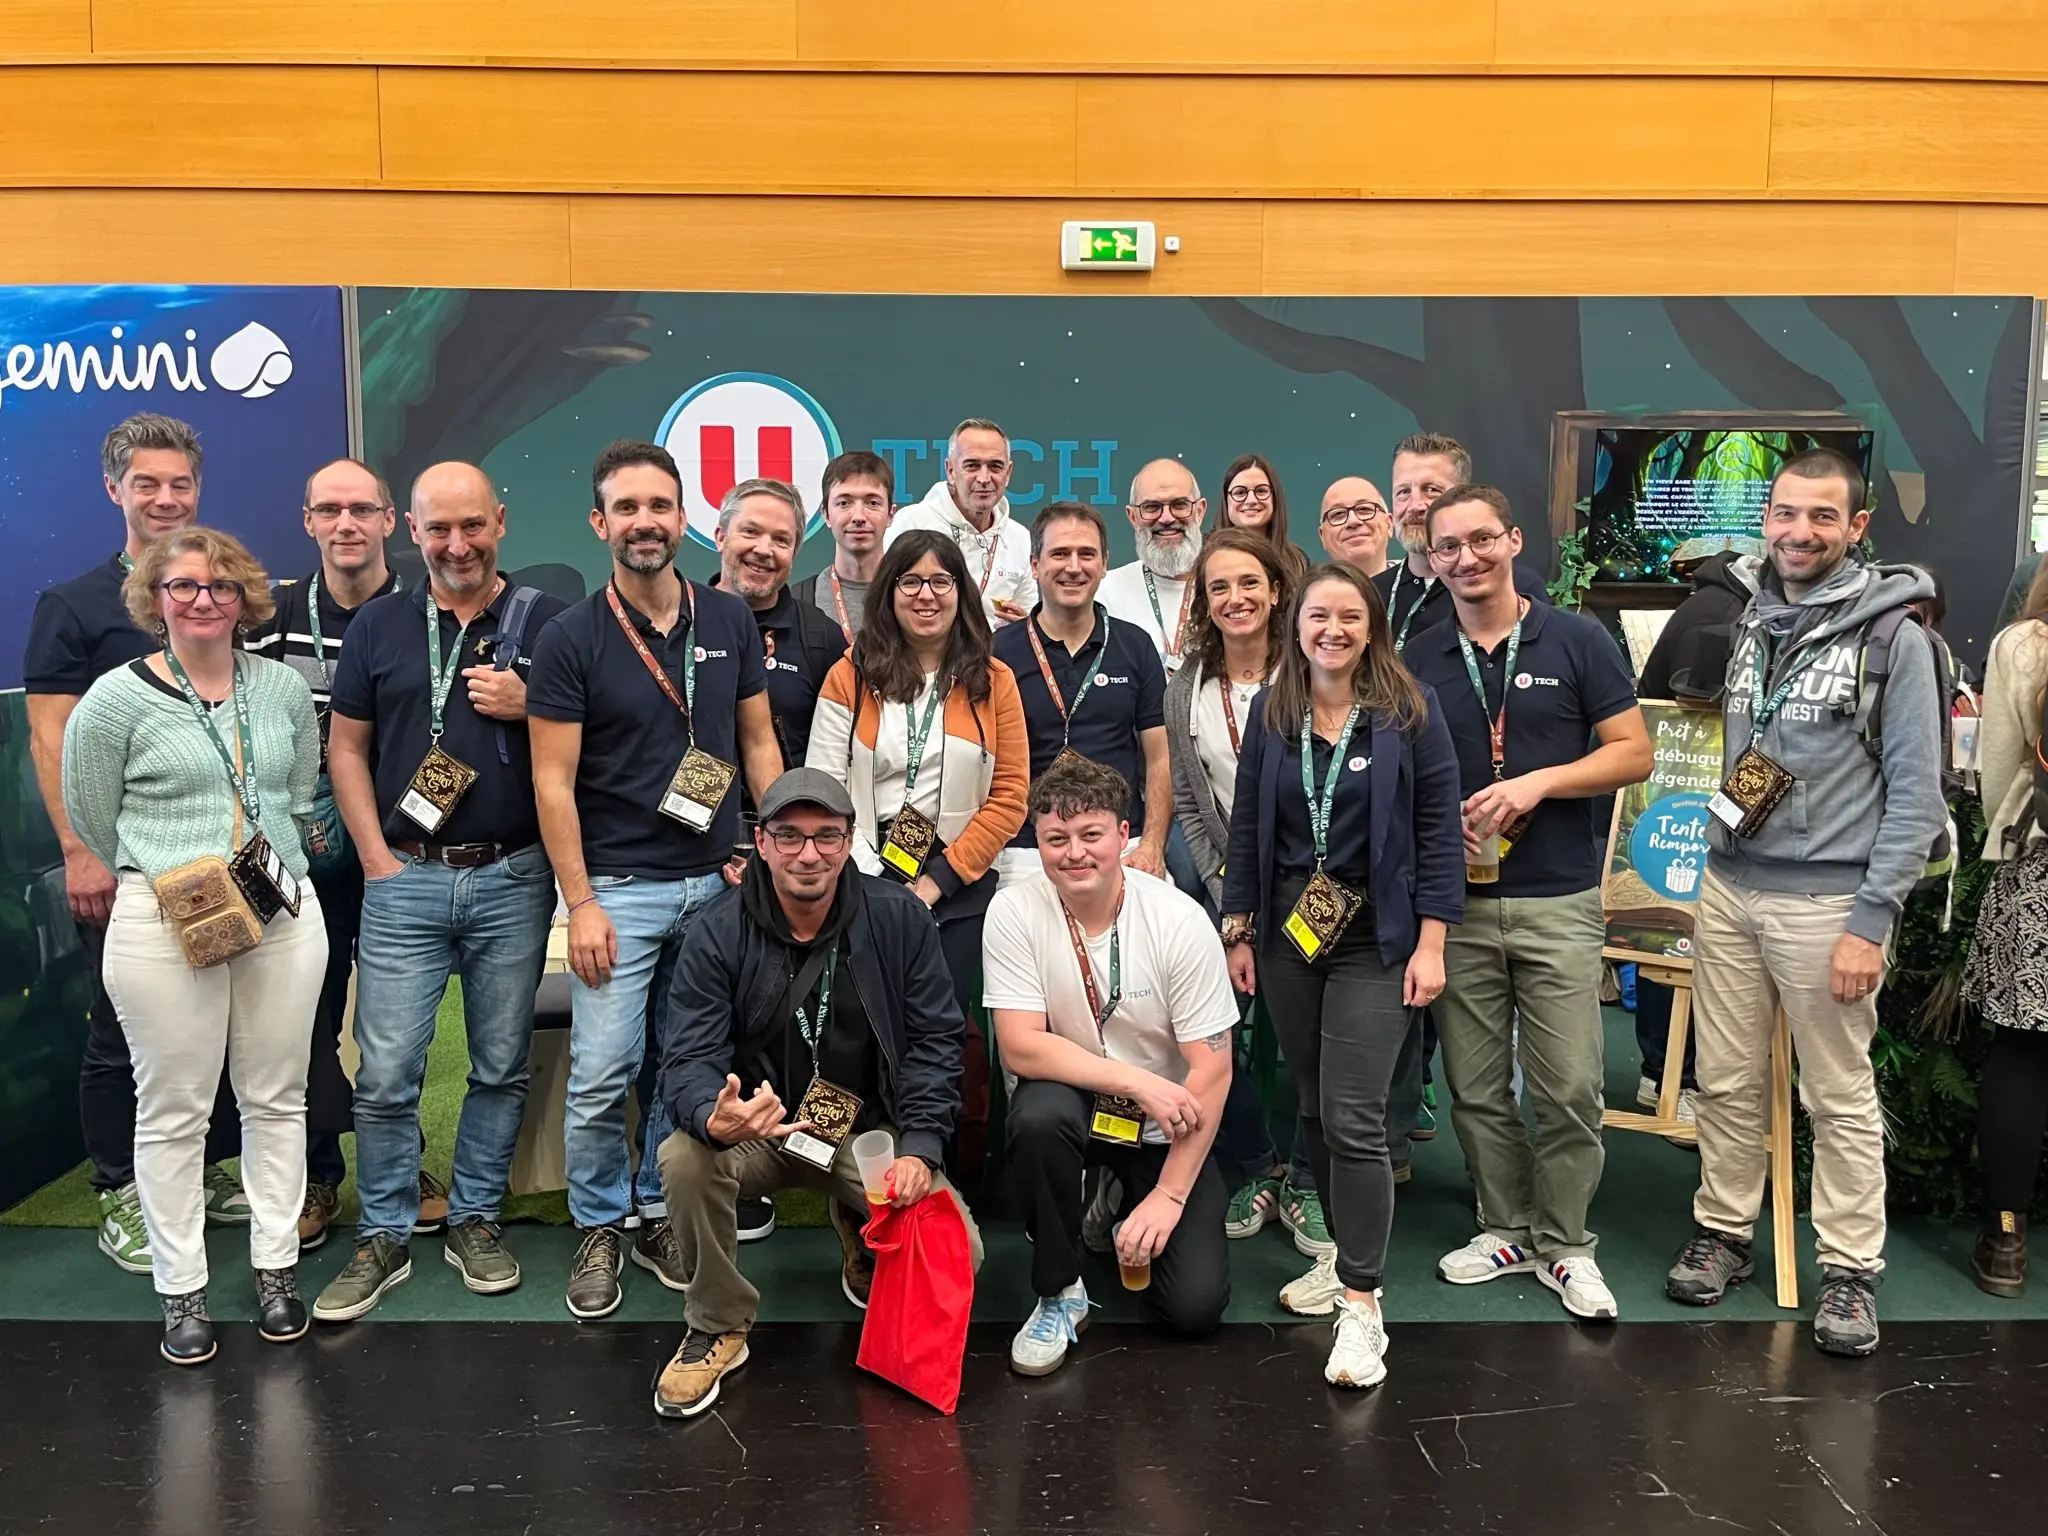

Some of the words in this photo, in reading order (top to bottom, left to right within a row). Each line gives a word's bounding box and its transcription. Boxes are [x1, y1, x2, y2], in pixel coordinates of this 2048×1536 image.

[0, 326, 207, 394] emini
[872, 439, 1118, 505] TCH
[707, 650, 728, 658] TECH
[778, 662, 798, 672] TECH
[1534, 677, 1559, 686] TECH
[1781, 702, 1823, 723] WEST
[1656, 720, 1693, 741] Prêt
[1695, 725, 1708, 739] à
[1129, 989, 1151, 999] TECH
